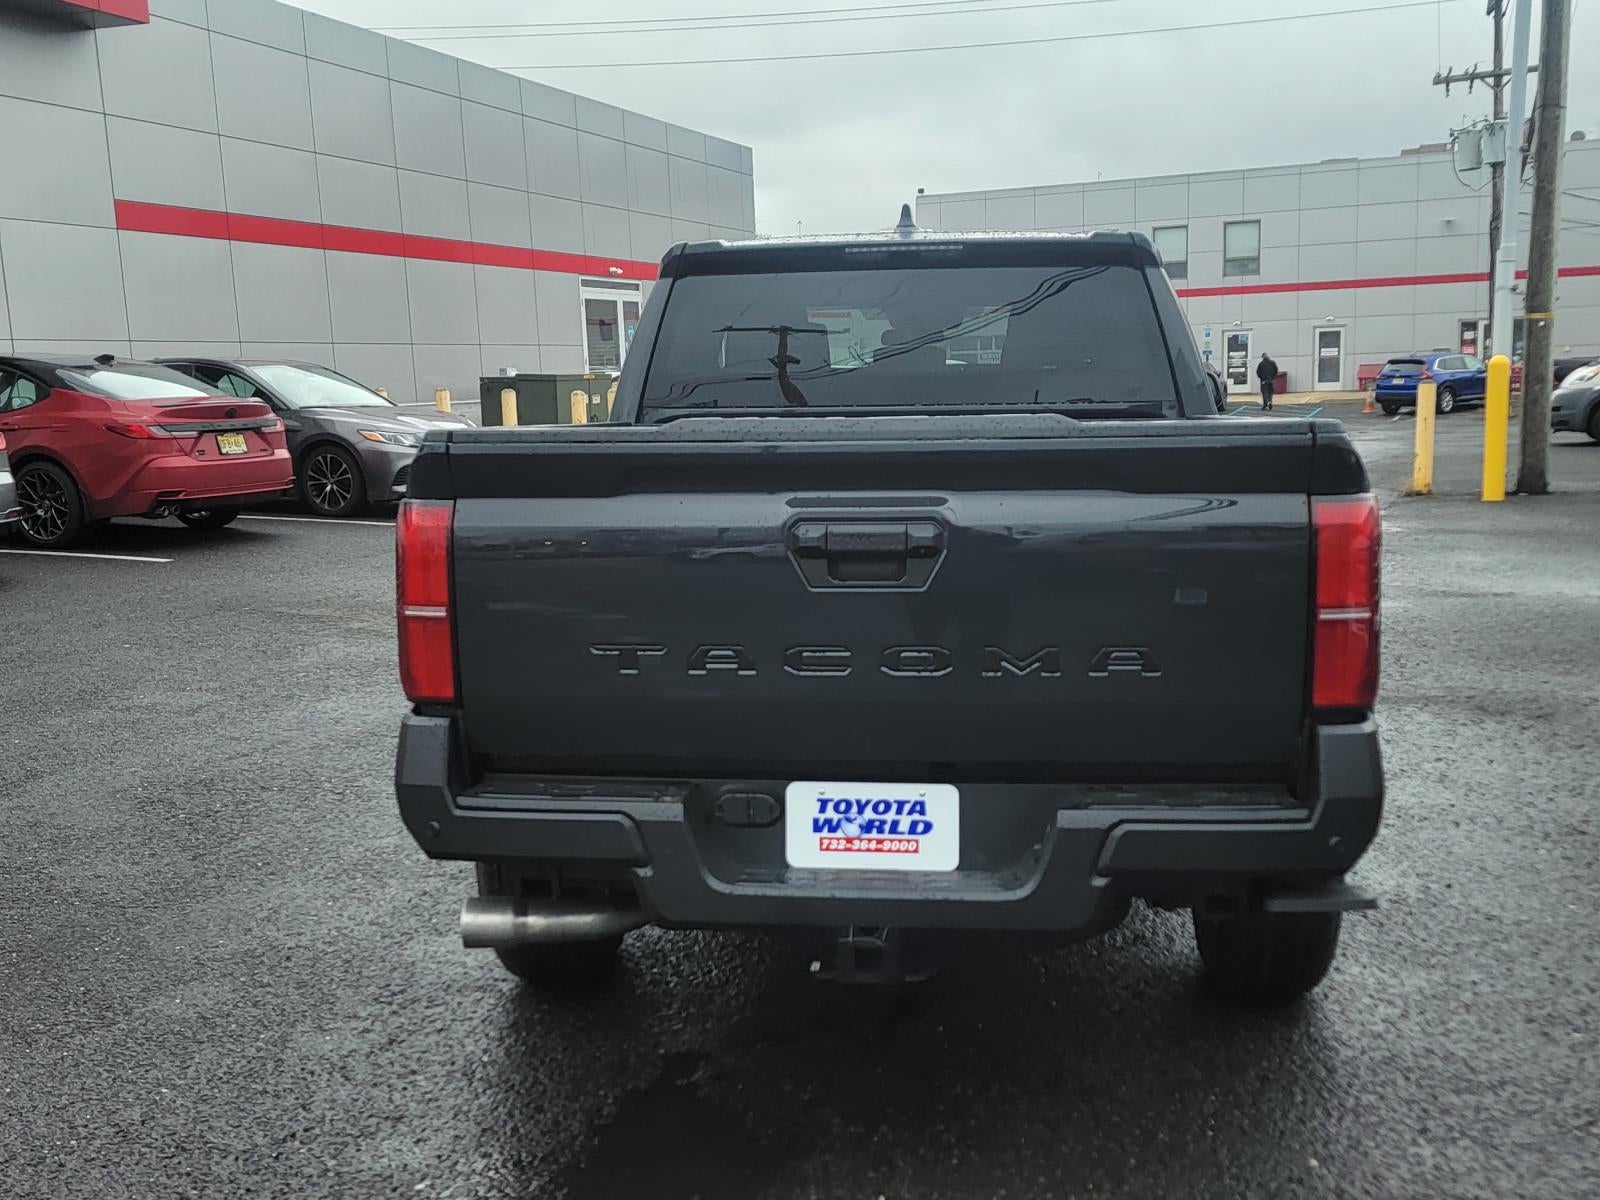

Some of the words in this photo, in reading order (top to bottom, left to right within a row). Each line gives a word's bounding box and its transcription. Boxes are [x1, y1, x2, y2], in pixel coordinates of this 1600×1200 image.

[588, 643, 1162, 677] TACOMA
[816, 797, 926, 816] TOYOTA
[812, 815, 934, 838] WORLD
[820, 839, 917, 851] 732-364-9000
